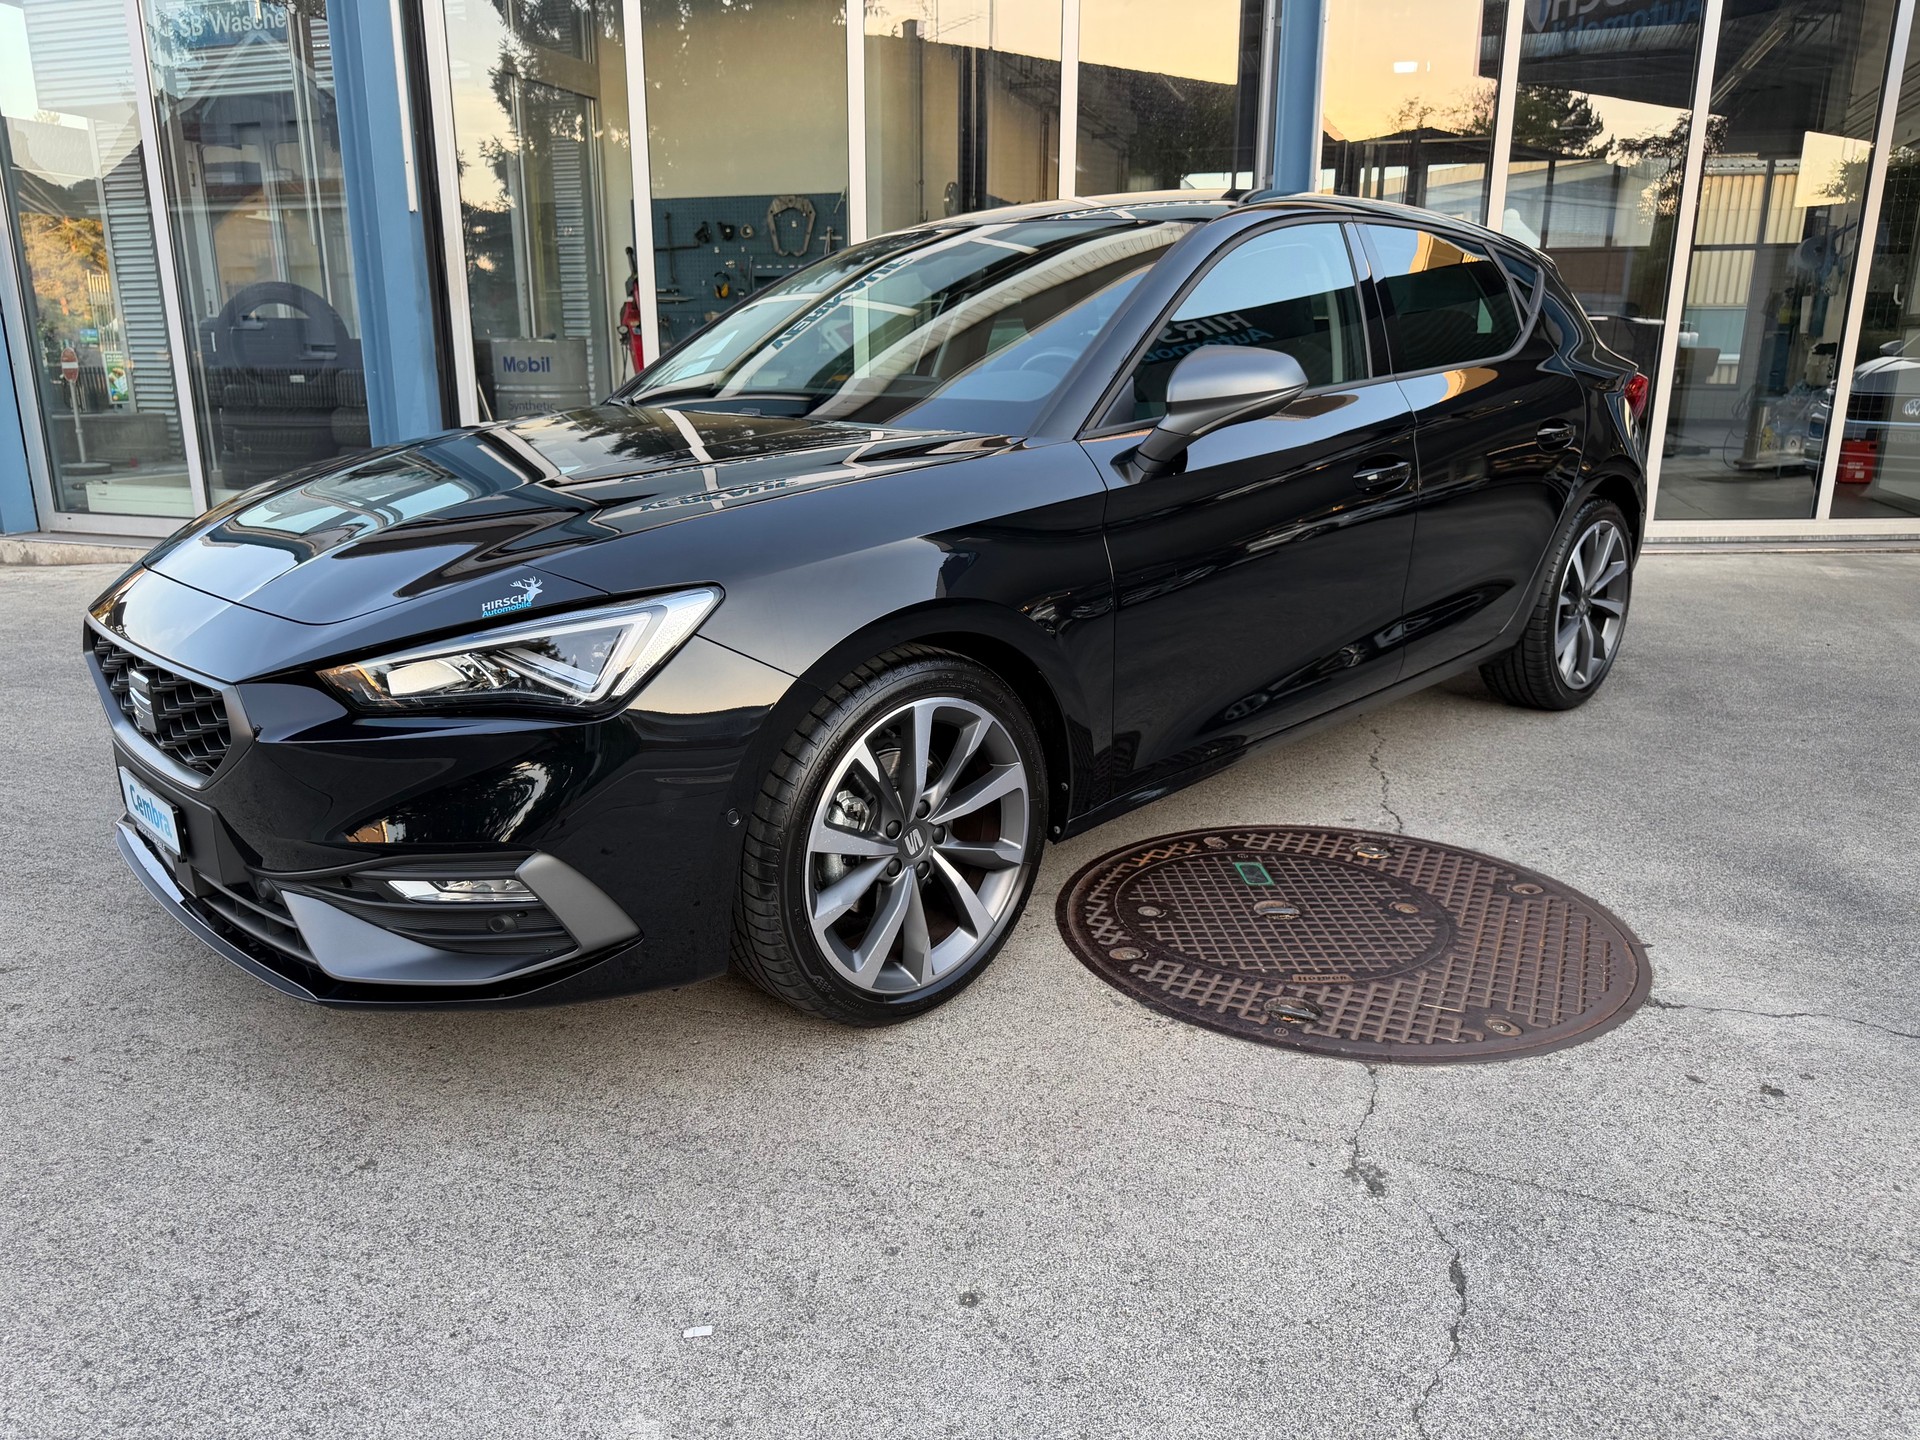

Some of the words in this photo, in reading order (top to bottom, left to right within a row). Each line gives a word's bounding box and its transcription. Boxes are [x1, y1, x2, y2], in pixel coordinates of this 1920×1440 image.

[209, 8, 287, 34] Wäsche
[503, 356, 551, 373] Mobil
[508, 399, 556, 414] Synthetic
[481, 593, 527, 612] HIRSCH
[481, 601, 532, 618] Automobile
[129, 784, 173, 839] Cembra
